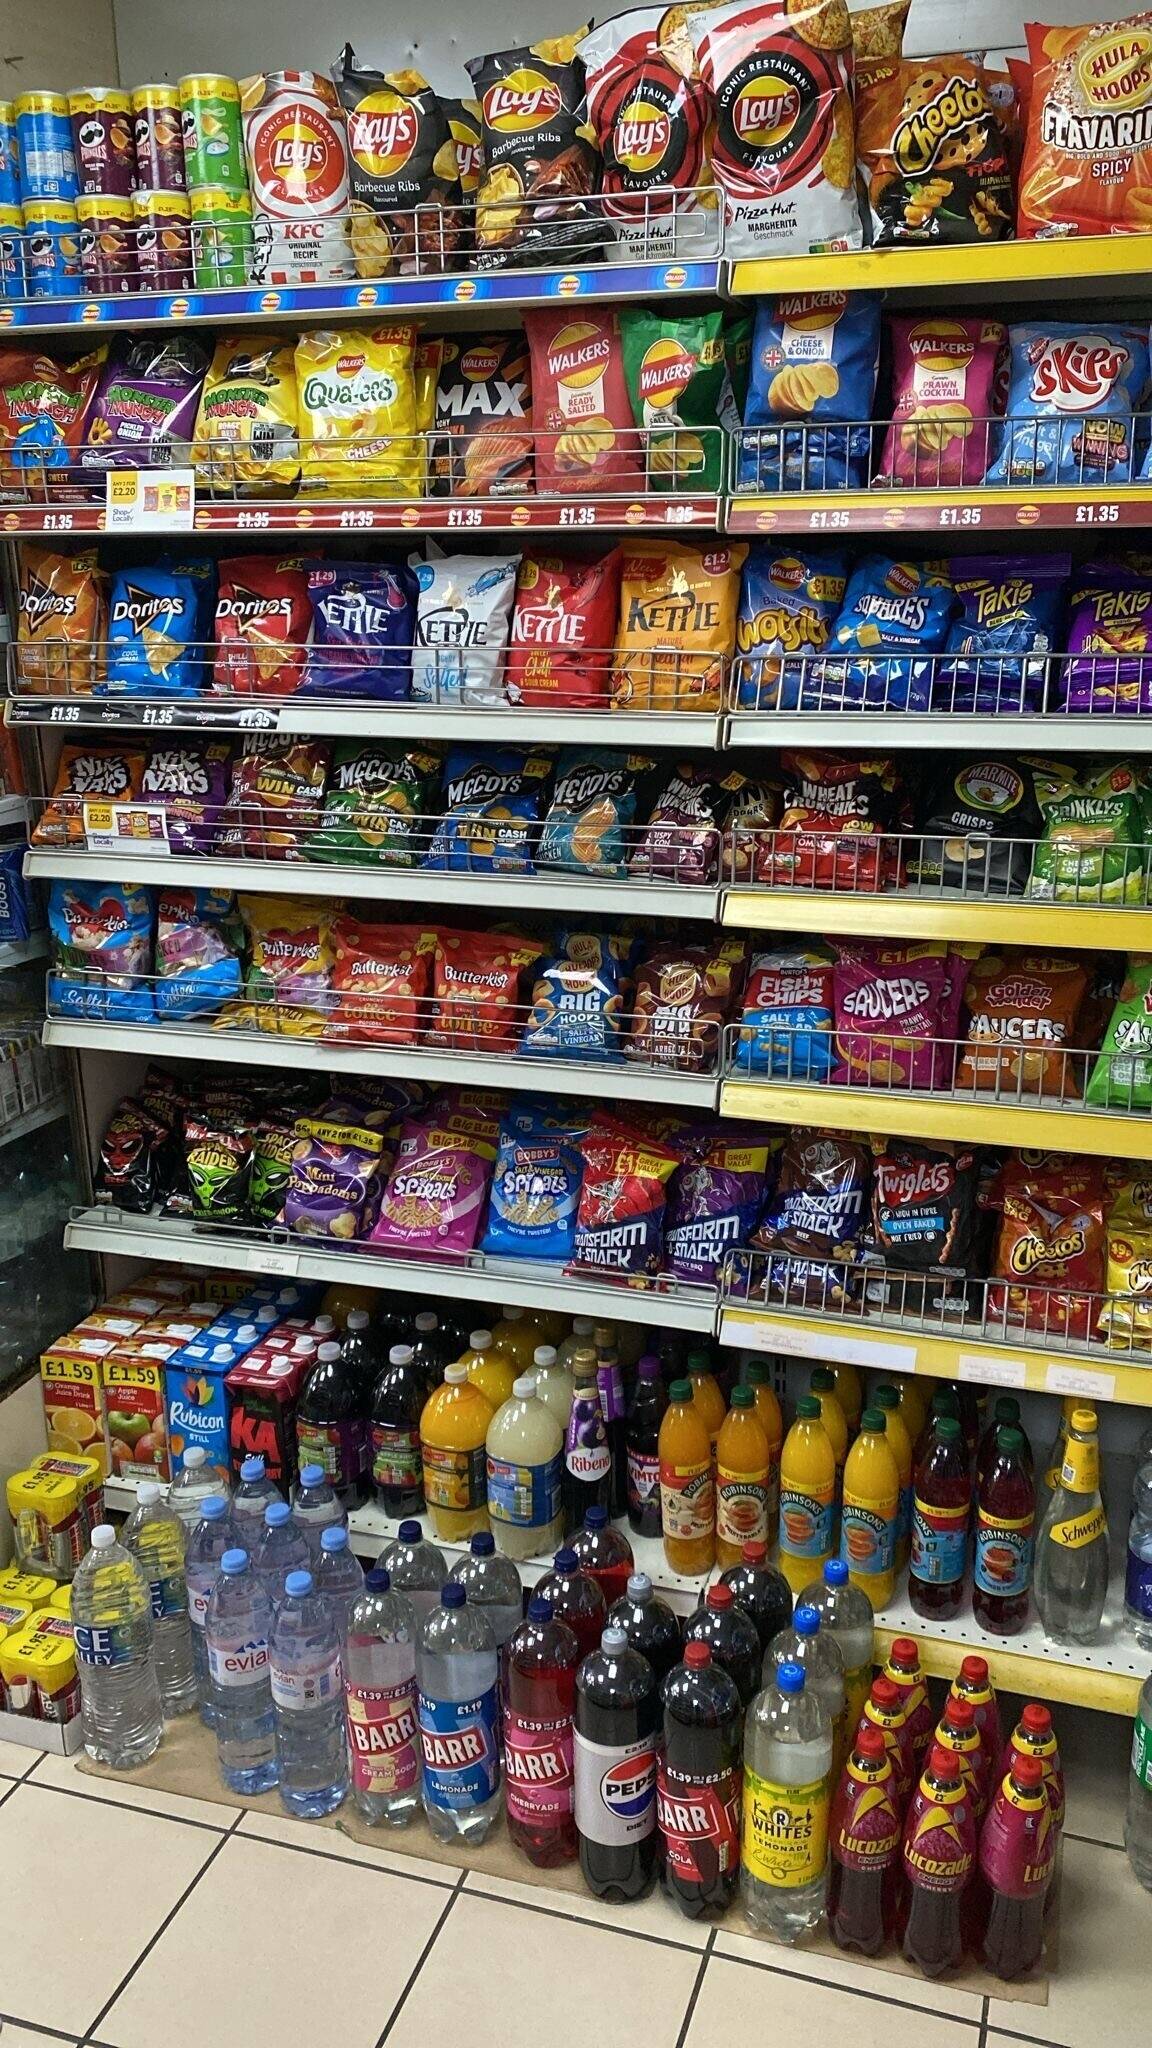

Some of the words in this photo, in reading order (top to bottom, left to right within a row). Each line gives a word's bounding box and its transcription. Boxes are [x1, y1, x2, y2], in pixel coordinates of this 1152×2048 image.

[1090, 42, 1144, 79] HULA
[721, 70, 747, 108] ICONIC
[749, 59, 812, 93] RESTAURANT
[1091, 66, 1151, 101] HOOPS
[488, 86, 561, 120] Lay's
[739, 91, 797, 132] Lay's
[258, 114, 283, 147] ICONIC
[353, 108, 412, 159] Lay's
[617, 119, 666, 156] Lay's
[491, 134, 534, 159] Barbecue
[537, 133, 562, 142] Ribs
[743, 141, 795, 166] FLAVOURS
[273, 140, 324, 170] Lay's
[1092, 158, 1132, 178] SPICY
[354, 181, 396, 193] Barbecue
[398, 181, 421, 192] Ribs
[1099, 177, 1124, 186] FLAVOUR
[734, 205, 769, 222] Pizza
[770, 202, 795, 217] Hut
[283, 223, 325, 240] KFC
[747, 218, 798, 232] MARGHERITA
[619, 229, 646, 242] Pizza
[753, 230, 794, 241] Geschmack
[293, 250, 319, 260] RECIPE
[779, 291, 848, 316] WALKERS
[376, 324, 412, 341] £1.35
[791, 338, 824, 348] CHEESE
[796, 346, 826, 357] ONION
[909, 339, 974, 355] WALKERS
[336, 356, 365, 371] WALKERS
[462, 357, 499, 368] WALKERS
[549, 340, 610, 375] WALKERS
[641, 363, 692, 390] WALKERS
[922, 380, 957, 390] PRAWN
[107, 385, 178, 415] MONSTER
[204, 386, 269, 407] MONSTER
[436, 381, 528, 418] MAX
[568, 395, 594, 407] READY
[919, 389, 960, 398] COCKTAIL
[106, 400, 168, 426] MUNCH
[205, 400, 259, 420] MUNCH
[568, 404, 596, 415] SALTED
[119, 421, 145, 432] PICKLED
[345, 435, 393, 462] CHEESE
[114, 487, 136, 496] £2.20
[43, 514, 73, 530] £1.35
[236, 511, 269, 528] £1.35
[340, 511, 374, 527] £1.35
[448, 509, 482, 525] £1.35
[558, 507, 596, 524] £1.35
[809, 511, 850, 528] £1.35
[940, 509, 981, 525] £1.35
[1075, 505, 1120, 522] £1.35
[310, 571, 335, 582] £1.29
[770, 568, 804, 581] WALKERS
[886, 568, 919, 592] WALKERS
[812, 580, 844, 596] £1.35
[113, 597, 184, 620] Doritos
[215, 597, 292, 619] Doritos
[762, 595, 796, 606] Baked
[973, 583, 1034, 623] Takis
[1092, 591, 1152, 622] Takis
[316, 595, 391, 634] KETTLE
[626, 591, 720, 632] KETTLE
[854, 595, 930, 630] SQUARES
[510, 603, 586, 643] KETTLE
[50, 707, 80, 722] £1.35
[142, 708, 173, 725] £1.35
[239, 711, 271, 728] £1.35
[74, 755, 123, 778] NIK
[149, 751, 201, 771] NIK
[73, 768, 128, 794] NAKS
[142, 768, 209, 796] NAKS
[257, 777, 295, 795] WIN
[297, 785, 323, 797] CASH
[967, 764, 1020, 795] MARMITE
[802, 780, 857, 802] WHEAT
[783, 788, 870, 817] CRUNCHIES
[1048, 799, 1124, 819] CRINKLYS
[89, 814, 111, 823] £2.20
[951, 811, 994, 830] CRISPS
[498, 829, 527, 839] CASH
[259, 941, 322, 961] Butterkist
[881, 951, 902, 963] £1
[351, 961, 413, 977] Butterkist
[445, 965, 509, 988] Butterkist
[760, 976, 807, 993] FISH
[989, 982, 1053, 998] Golden
[756, 988, 824, 1007] CHIPS
[843, 978, 931, 1020] SAUCERS
[760, 1013, 791, 1024] SALT
[900, 1012, 925, 1028] PRAWN
[970, 1014, 1066, 1042] SAUCERS
[563, 1035, 601, 1045] VINEGAR
[353, 1133, 374, 1146] £1.35
[517, 1148, 557, 1161] BOBBY'S
[638, 1156, 664, 1170] GREAT
[727, 1153, 752, 1162] GREAT
[615, 1154, 635, 1174] £1
[638, 1163, 663, 1174] VALUE
[727, 1159, 752, 1168] VALUE
[306, 1166, 336, 1183] Mini
[872, 1162, 950, 1204] Twiglets
[286, 1174, 359, 1201] Poppadoms
[1003, 1206, 1031, 1222] BAG
[665, 1215, 740, 1241] TRANSFORM
[892, 1220, 912, 1231] OVEN
[914, 1219, 936, 1229] BAKED
[574, 1221, 648, 1247] TRANSFORM
[796, 1229, 810, 1240] BEEF
[1011, 1231, 1085, 1274] Cheetos
[45, 1361, 94, 1381] £1.59
[108, 1365, 156, 1385] £1.59
[54, 1382, 81, 1392] Orange
[117, 1386, 138, 1396] Apple
[117, 1393, 136, 1402] Juice
[170, 1400, 225, 1430] Rubicon
[188, 1432, 210, 1444] STILL
[230, 1406, 281, 1464] KA
[570, 1453, 610, 1472] Ribena
[22, 1471, 50, 1490] £1.95
[722, 1484, 769, 1500] ROBINSONS
[979, 1529, 1027, 1548] ROBINSONS
[18, 1632, 47, 1657] £1.95
[273, 1673, 296, 1686] evian
[357, 1688, 382, 1701] £1.39
[457, 1700, 483, 1716] £1.19
[355, 1709, 415, 1752] BARR
[517, 1719, 542, 1732] £1.39
[422, 1733, 482, 1767] BARR
[625, 1740, 648, 1755] £2.10
[952, 1741, 964, 1750] £2
[1033, 1747, 1045, 1756] £2
[361, 1766, 392, 1779] CREAM
[506, 1749, 561, 1784] BARR
[666, 1766, 692, 1784] £1.39
[705, 1767, 733, 1784] £2.50
[867, 1773, 879, 1783] £2
[431, 1782, 480, 1794] LEMONADE
[509, 1792, 561, 1812] CHERRYADE
[934, 1793, 947, 1803] £2
[626, 1819, 648, 1832] DIET
[775, 1811, 786, 1826] R
[752, 1816, 813, 1839] WHITES
[752, 1835, 809, 1852] LEMONADE
[668, 1849, 693, 1866] COLA
[904, 1839, 973, 1877] Lucozade
[917, 1871, 959, 1886] ENERGY
